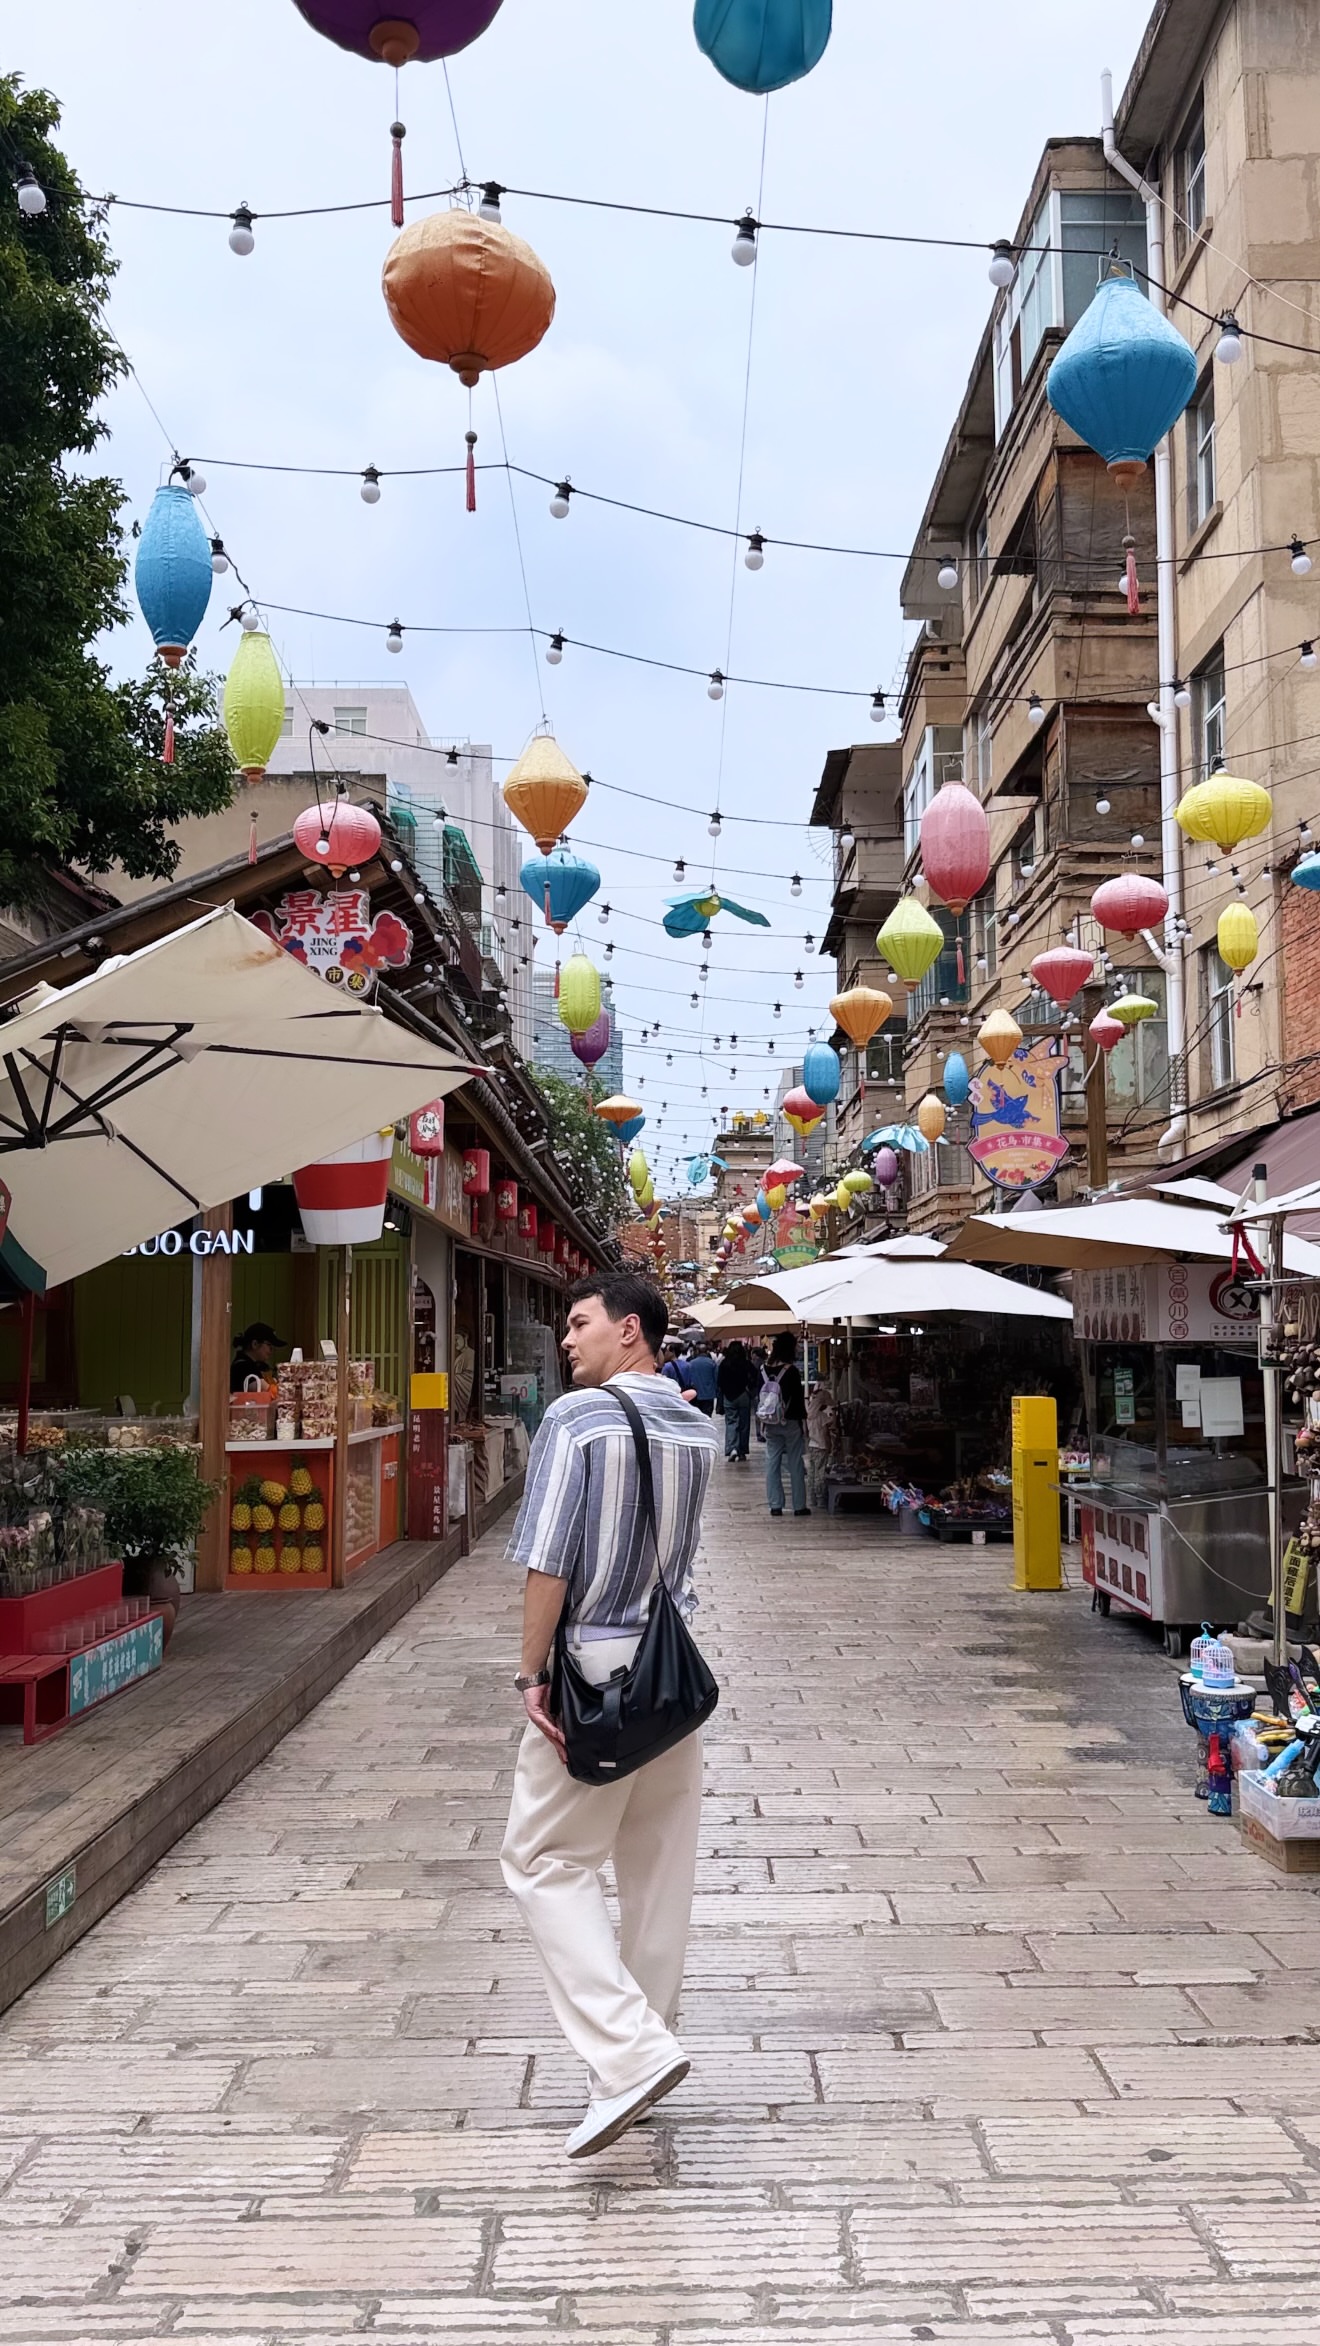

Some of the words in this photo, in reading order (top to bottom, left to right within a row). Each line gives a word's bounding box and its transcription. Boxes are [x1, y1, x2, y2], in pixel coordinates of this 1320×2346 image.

[279, 892, 368, 936] 景星
[310, 938, 337, 946] JING
[310, 947, 338, 956] XING
[123, 1230, 182, 1255] UO
[190, 1229, 254, 1255] GAN
